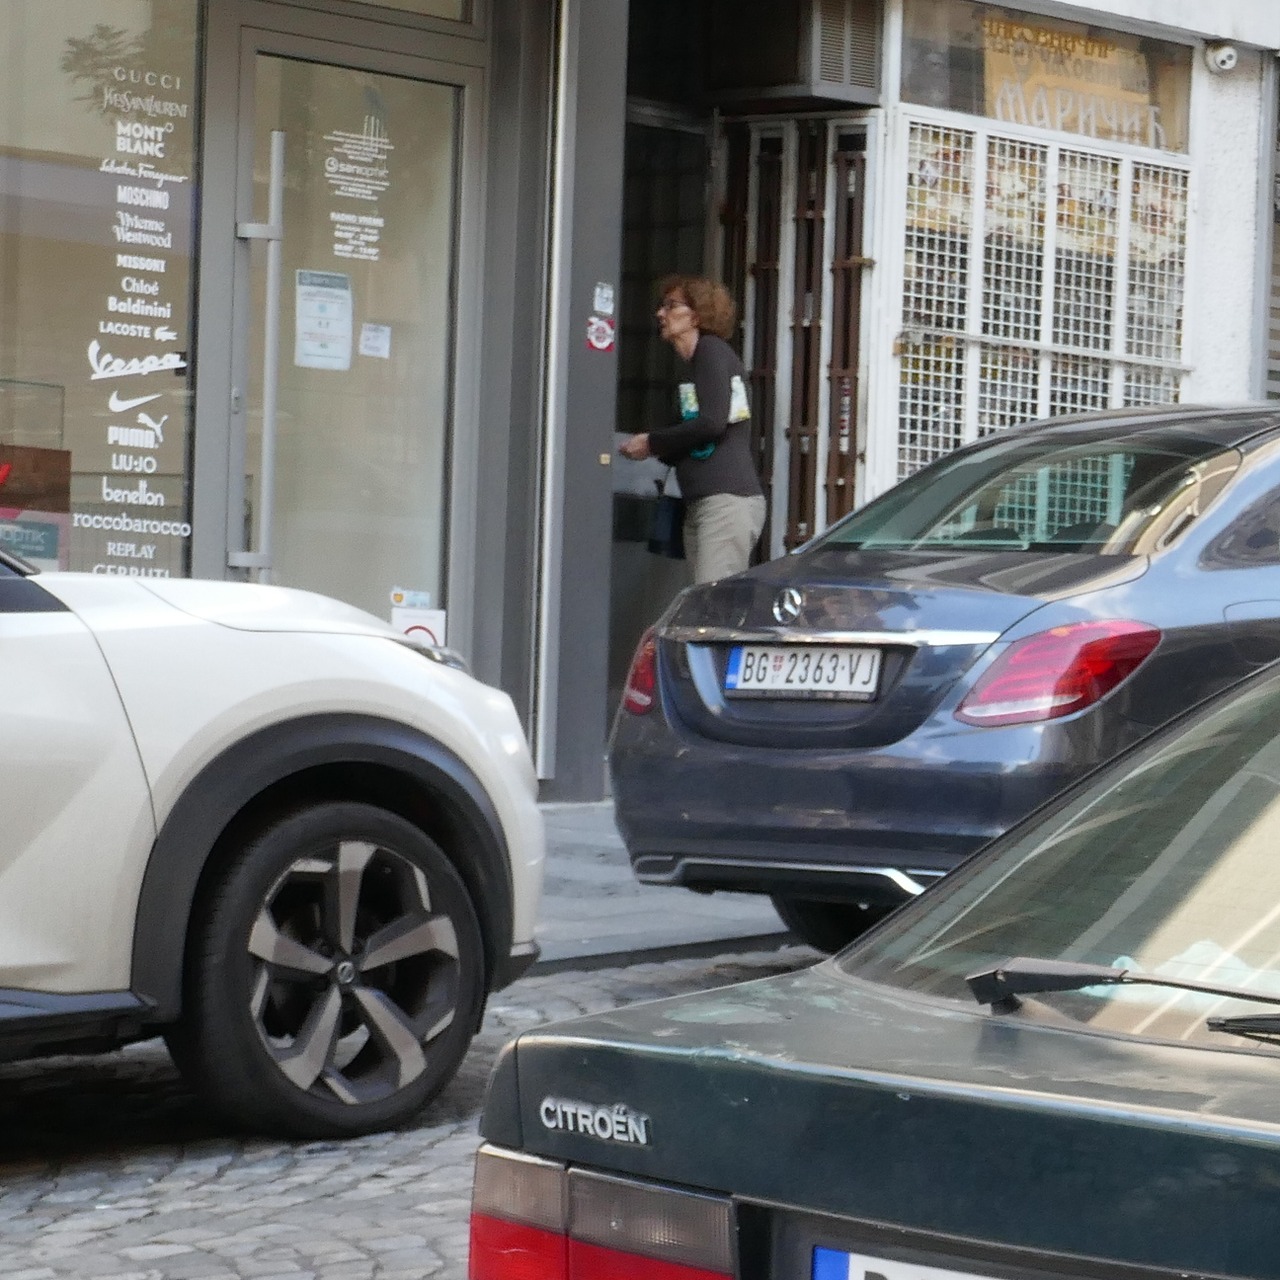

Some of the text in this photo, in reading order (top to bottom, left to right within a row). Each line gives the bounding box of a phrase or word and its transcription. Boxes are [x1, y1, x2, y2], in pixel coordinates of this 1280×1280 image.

[114, 66, 181, 90] GUCCI
[116, 120, 165, 142] MONT
[116, 136, 165, 158] BLANC
[116, 184, 170, 210] MOSCHINO
[112, 224, 172, 248] Westwood
[116, 253, 166, 273] MISSONI
[121, 276, 159, 296] Chloé
[107, 296, 172, 319] Baldinini
[100, 320, 151, 339] LACOSTE
[88, 339, 188, 380] Vespa
[107, 425, 156, 449] PUMA
[102, 475, 165, 507] benetton
[72, 512, 192, 538] roccobarocco
[106, 541, 157, 560] REPLAY
[743, 652, 769, 683] BG
[539, 1096, 650, 1146] CITROËN
